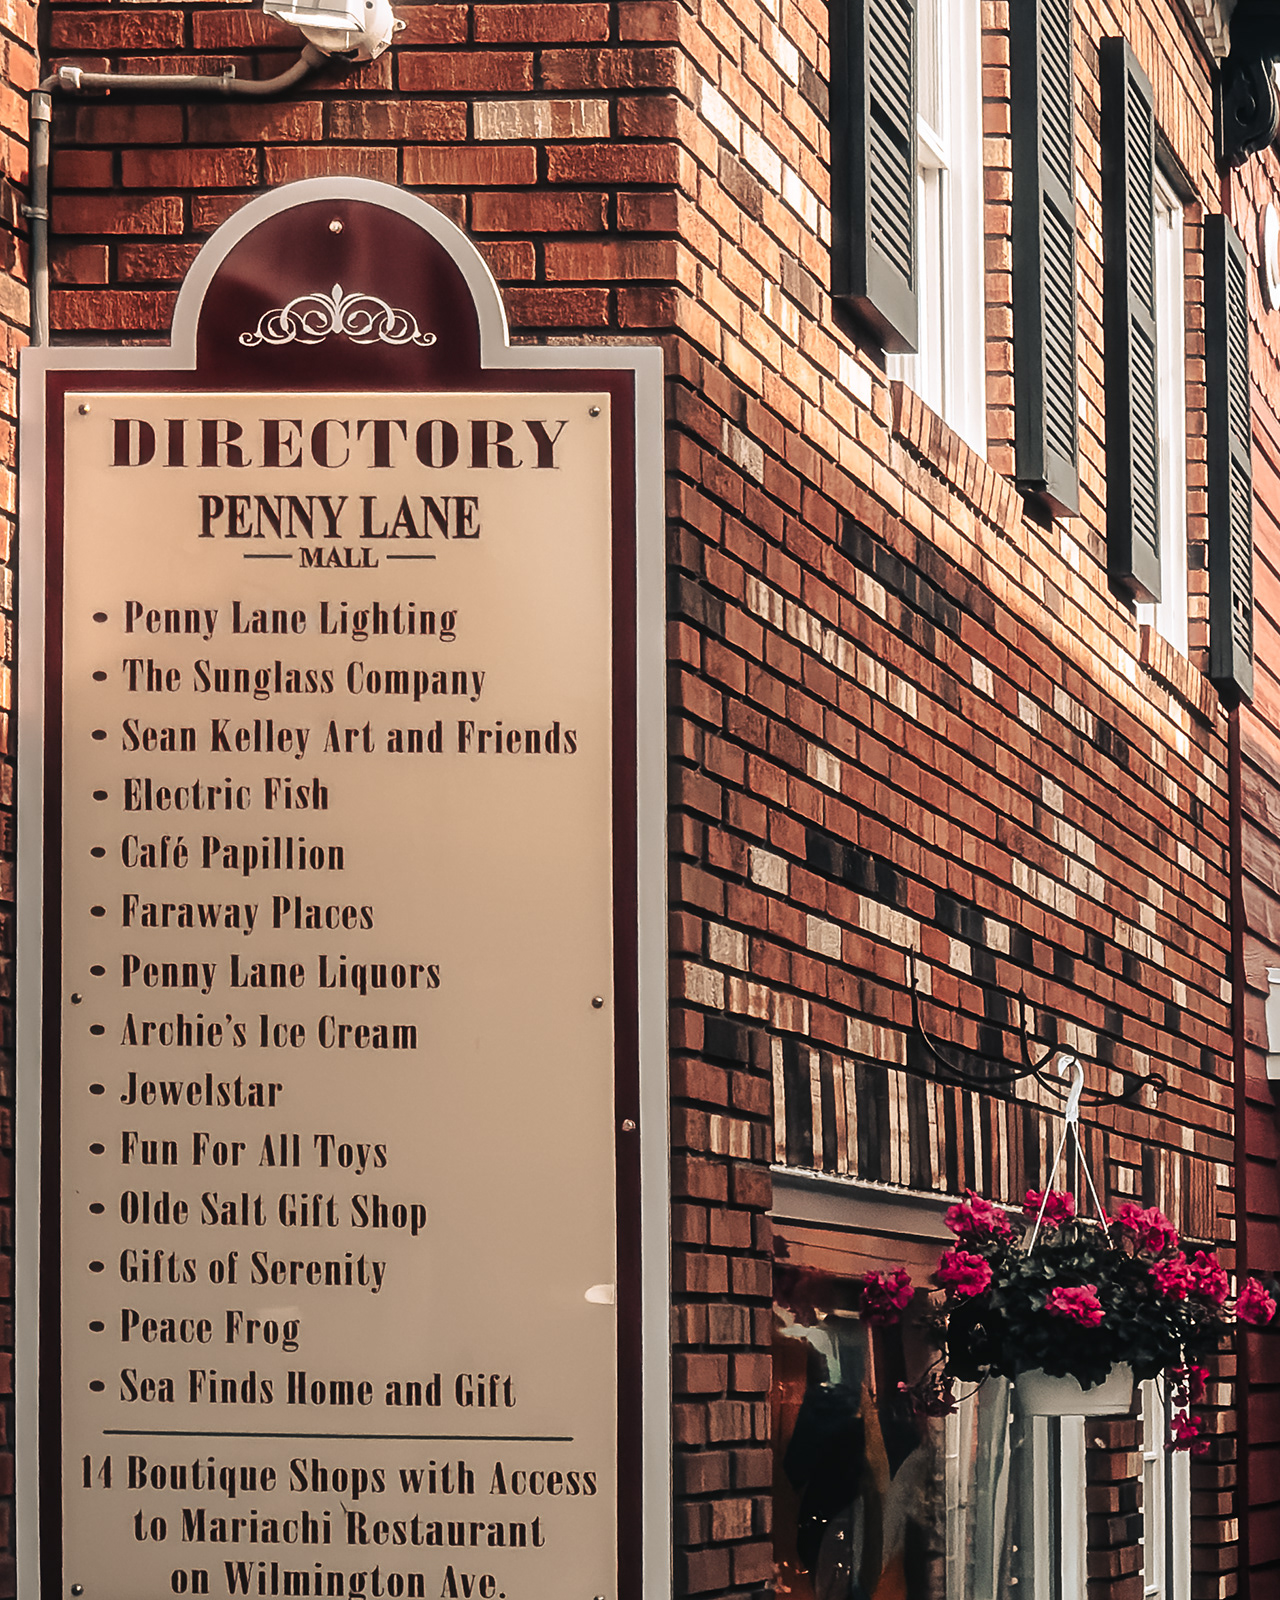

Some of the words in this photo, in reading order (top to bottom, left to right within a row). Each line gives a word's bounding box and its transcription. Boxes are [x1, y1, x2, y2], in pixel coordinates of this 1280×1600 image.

[108, 418, 570, 470] DIRECTORY
[197, 494, 349, 540] PENNY
[358, 494, 481, 540] LANE
[298, 545, 380, 569] MALL
[124, 600, 219, 642] Penny
[231, 600, 307, 635] Lane
[319, 601, 458, 643] Lighting
[122, 658, 181, 693] The
[193, 658, 334, 702] Sunglass
[346, 660, 486, 703] Company
[122, 717, 197, 752] Sean
[210, 718, 311, 761] Kelley
[322, 719, 376, 754] Art
[386, 719, 444, 754] and
[457, 719, 578, 755] Friends
[122, 776, 251, 812] Electric
[263, 776, 329, 811] Fish
[121, 834, 189, 869] Café
[200, 835, 345, 874] Papillion
[121, 893, 259, 937] Faraway
[271, 895, 374, 931] Places
[121, 953, 218, 996] Penny
[229, 953, 306, 989] Lane
[317, 954, 441, 997] Liquors
[119, 1012, 247, 1048] Archie's
[258, 1013, 306, 1049] Ice
[318, 1014, 417, 1050] Cream
[119, 1071, 283, 1108] Jewelstar
[121, 1130, 179, 1166] Fun
[191, 1131, 247, 1167] For
[258, 1133, 301, 1168] All
[313, 1133, 388, 1176] Toys
[120, 1190, 189, 1226] Olde
[200, 1191, 267, 1227] Salt
[278, 1192, 340, 1228] Gift
[350, 1193, 427, 1237] Shop
[119, 1248, 197, 1284] Gifts
[208, 1250, 239, 1285] of
[250, 1250, 387, 1294] Serenity
[120, 1308, 213, 1344] Peace
[224, 1309, 301, 1353] Frog
[120, 1367, 175, 1403] Sea
[187, 1369, 274, 1405] Finds
[286, 1370, 374, 1406] Home
[385, 1372, 442, 1407] and
[454, 1373, 517, 1408] Gift
[81, 1454, 113, 1489] 14
[127, 1455, 277, 1499] Boutique
[289, 1457, 386, 1501] Shops
[398, 1459, 475, 1496] with
[488, 1461, 597, 1496] Access
[133, 1508, 168, 1542] to
[180, 1506, 332, 1545] Mariachi
[344, 1509, 547, 1548] Restaurant
[170, 1566, 210, 1597] on
[439, 1564, 506, 1600] Ave.
